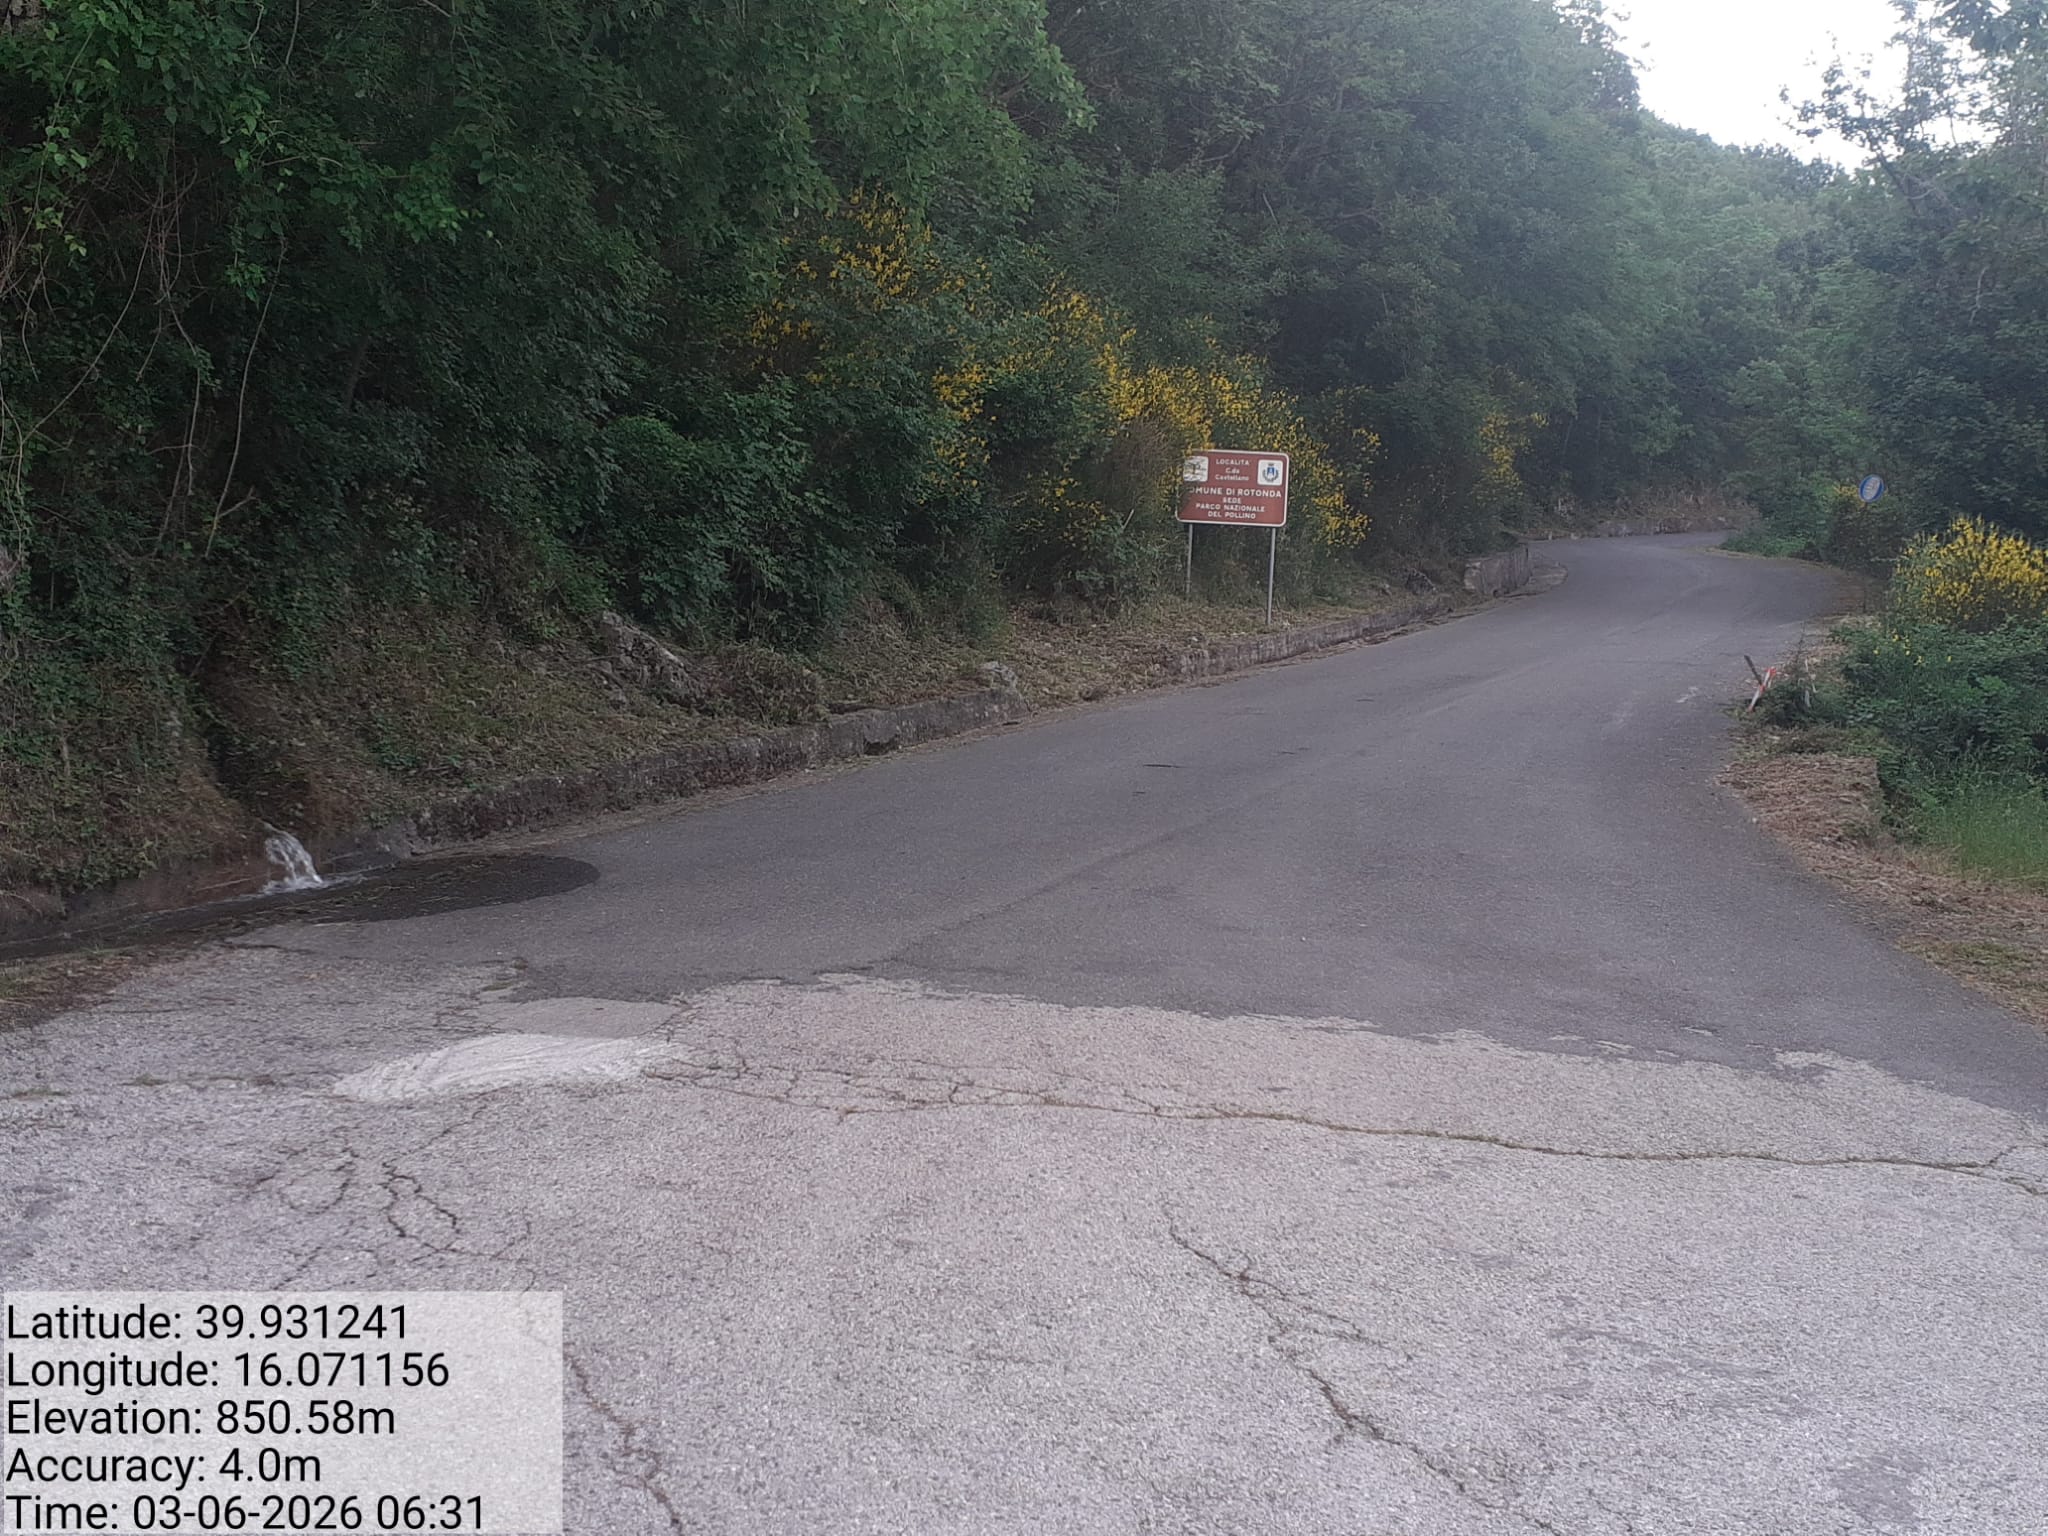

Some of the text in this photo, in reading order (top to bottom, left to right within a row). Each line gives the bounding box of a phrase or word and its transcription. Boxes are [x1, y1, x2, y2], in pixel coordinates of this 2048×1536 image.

[1187, 487, 1282, 498] OMUNE DI ROTONDA
[1223, 504, 1265, 512] NAZIONALE
[1225, 511, 1256, 519] POLLINO
